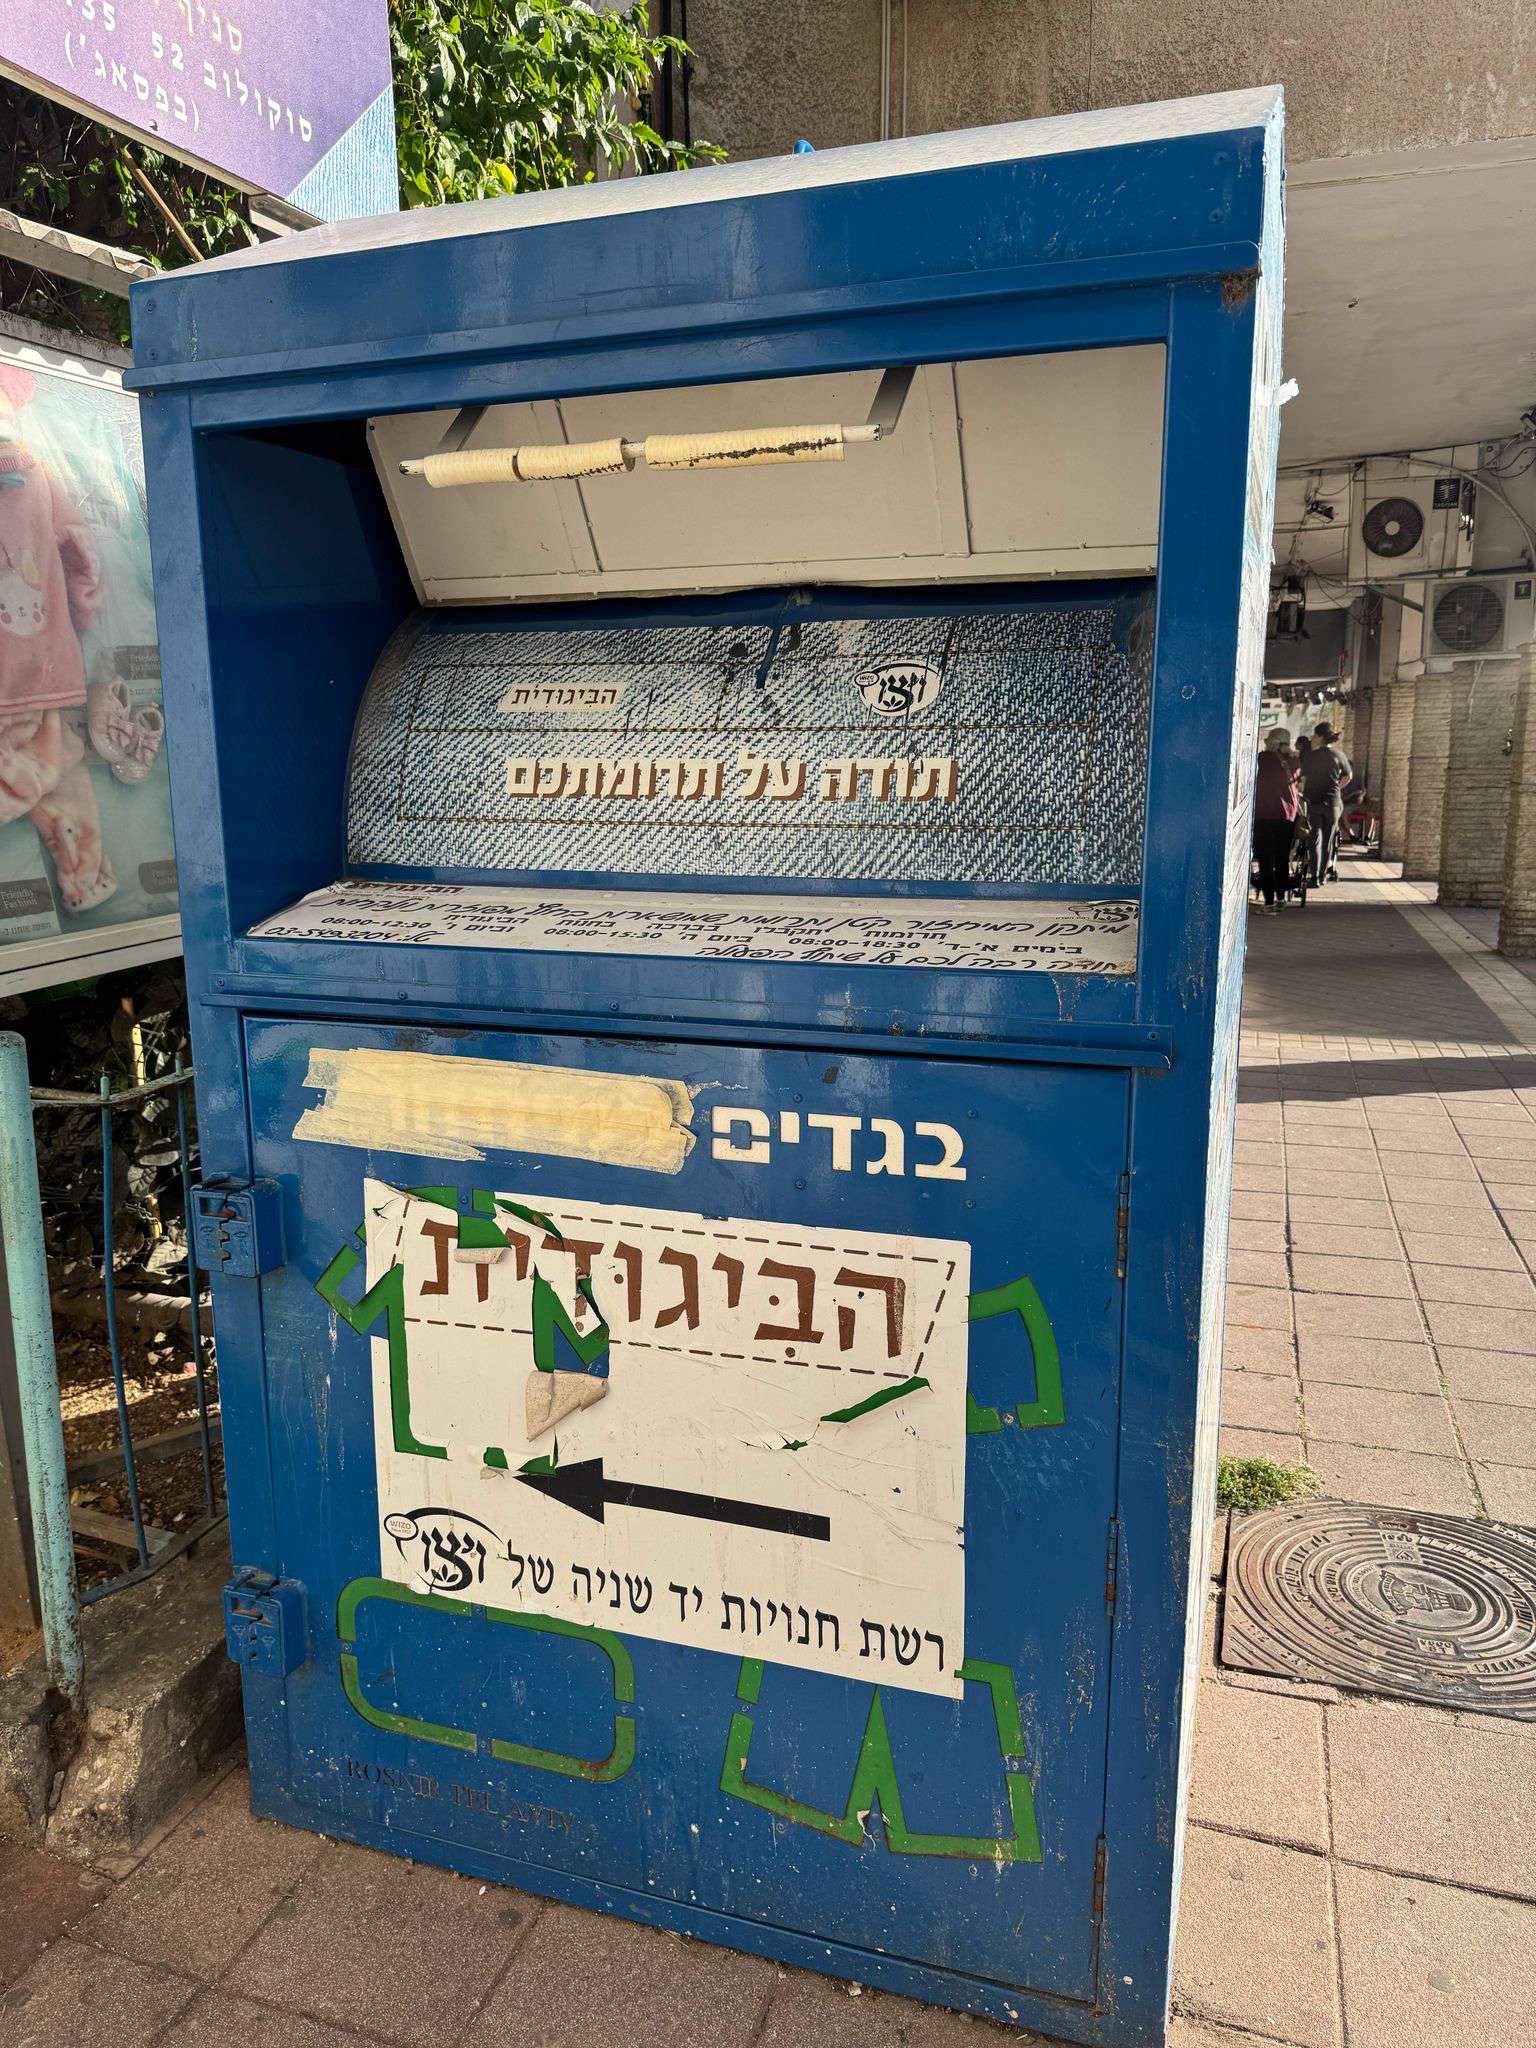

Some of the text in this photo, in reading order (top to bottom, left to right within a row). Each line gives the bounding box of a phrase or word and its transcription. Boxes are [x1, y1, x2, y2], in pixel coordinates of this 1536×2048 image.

[152, 30, 184, 71] 52
[204, 61, 312, 142] סוקולוב
[505, 751, 958, 801] תודה על תרומתכם
[463, 924, 516, 934] וביום
[555, 919, 616, 928] בחנות
[646, 923, 721, 931] בברכה
[826, 916, 892, 933] קטן
[907, 920, 1035, 931] המיחזור
[1035, 923, 1130, 937] מיתקן
[708, 935, 754, 943] ביום
[864, 930, 947, 940] תרומות
[1012, 944, 1083, 954] בימים
[868, 950, 903, 964] על
[905, 953, 980, 966] לכם
[968, 958, 1038, 969] רבה
[712, 1106, 967, 1181] בגדים
[421, 1526, 945, 1672] רשת חנויות יד שניה של ויצו
